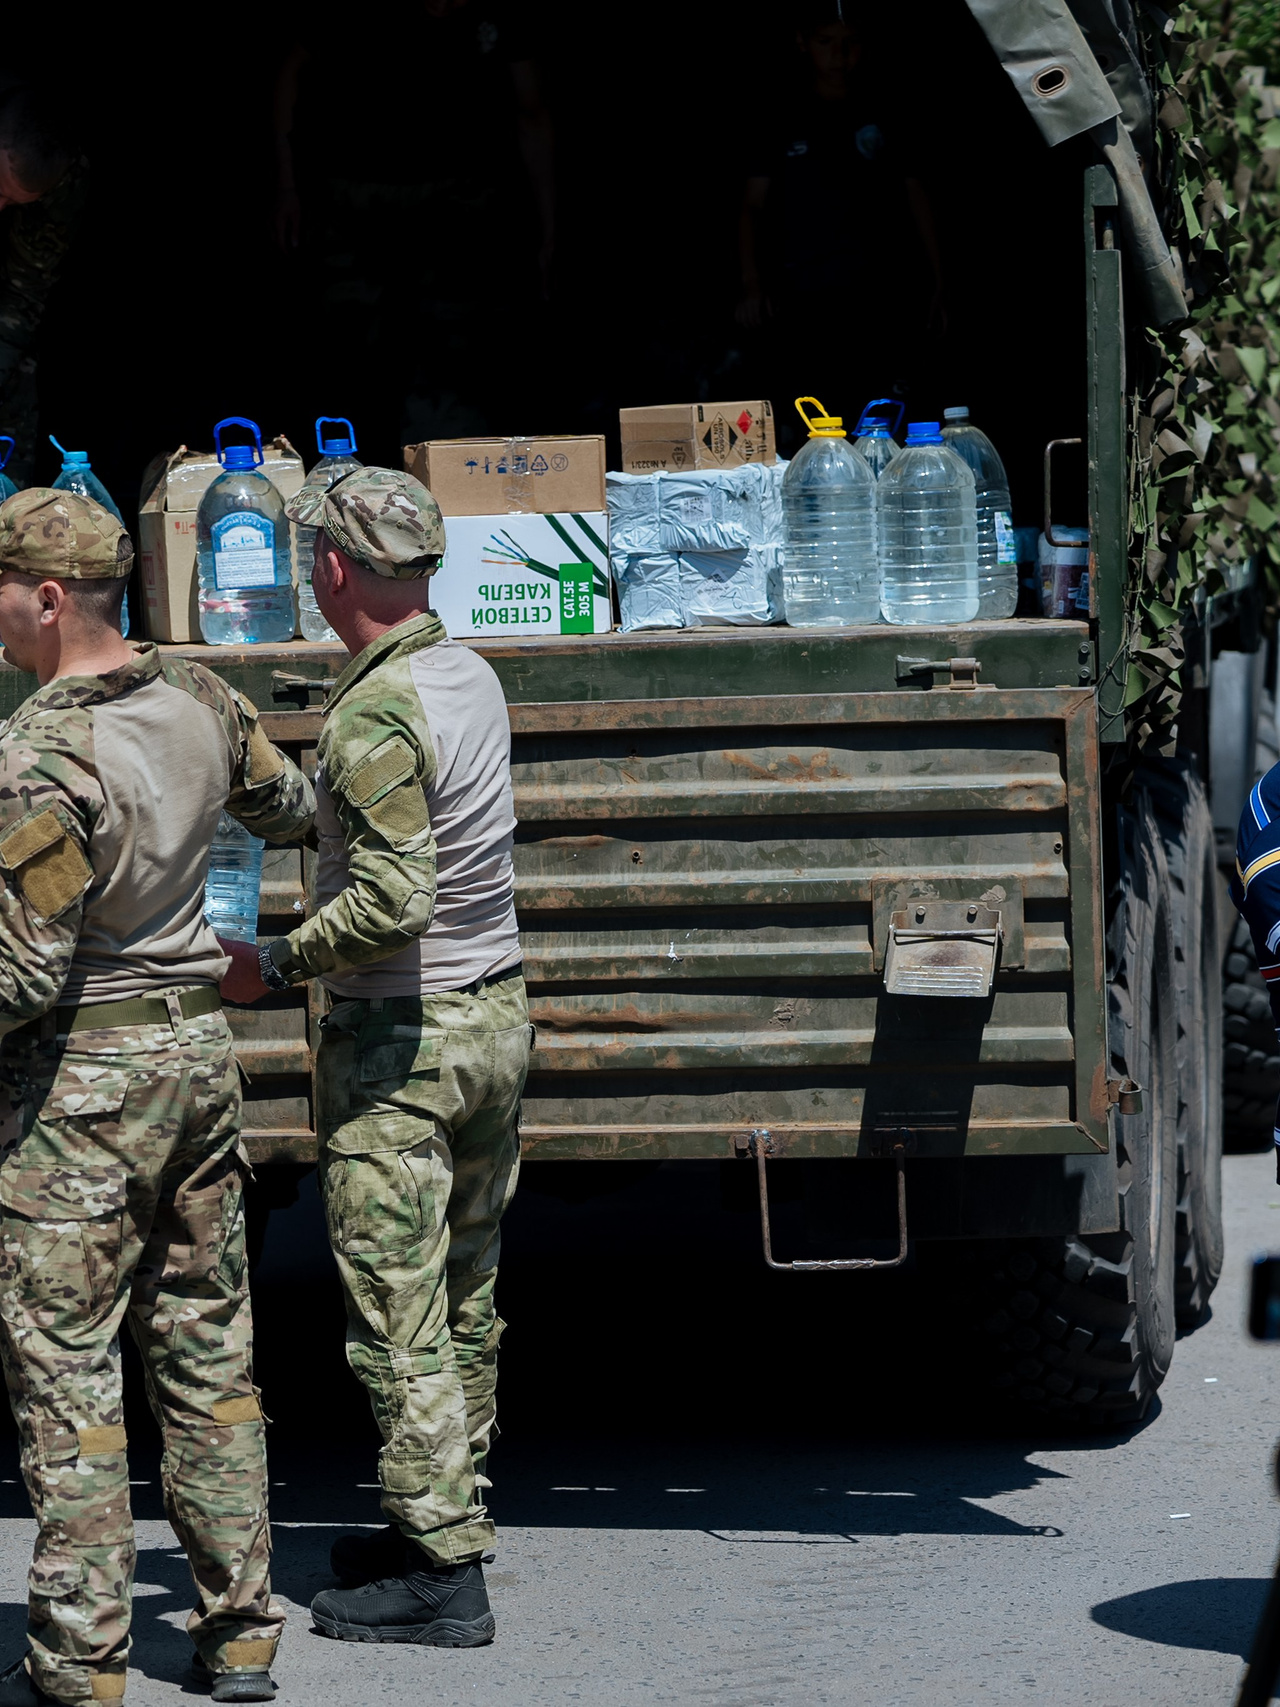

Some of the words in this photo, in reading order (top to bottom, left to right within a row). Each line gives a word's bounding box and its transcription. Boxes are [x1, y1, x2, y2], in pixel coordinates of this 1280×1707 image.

[478, 583, 551, 601] КАБЕЛЬ
[563, 580, 575, 619] CAT.5E
[579, 595, 590, 617] 305
[471, 606, 552, 629] СЕТЕВОЙ
